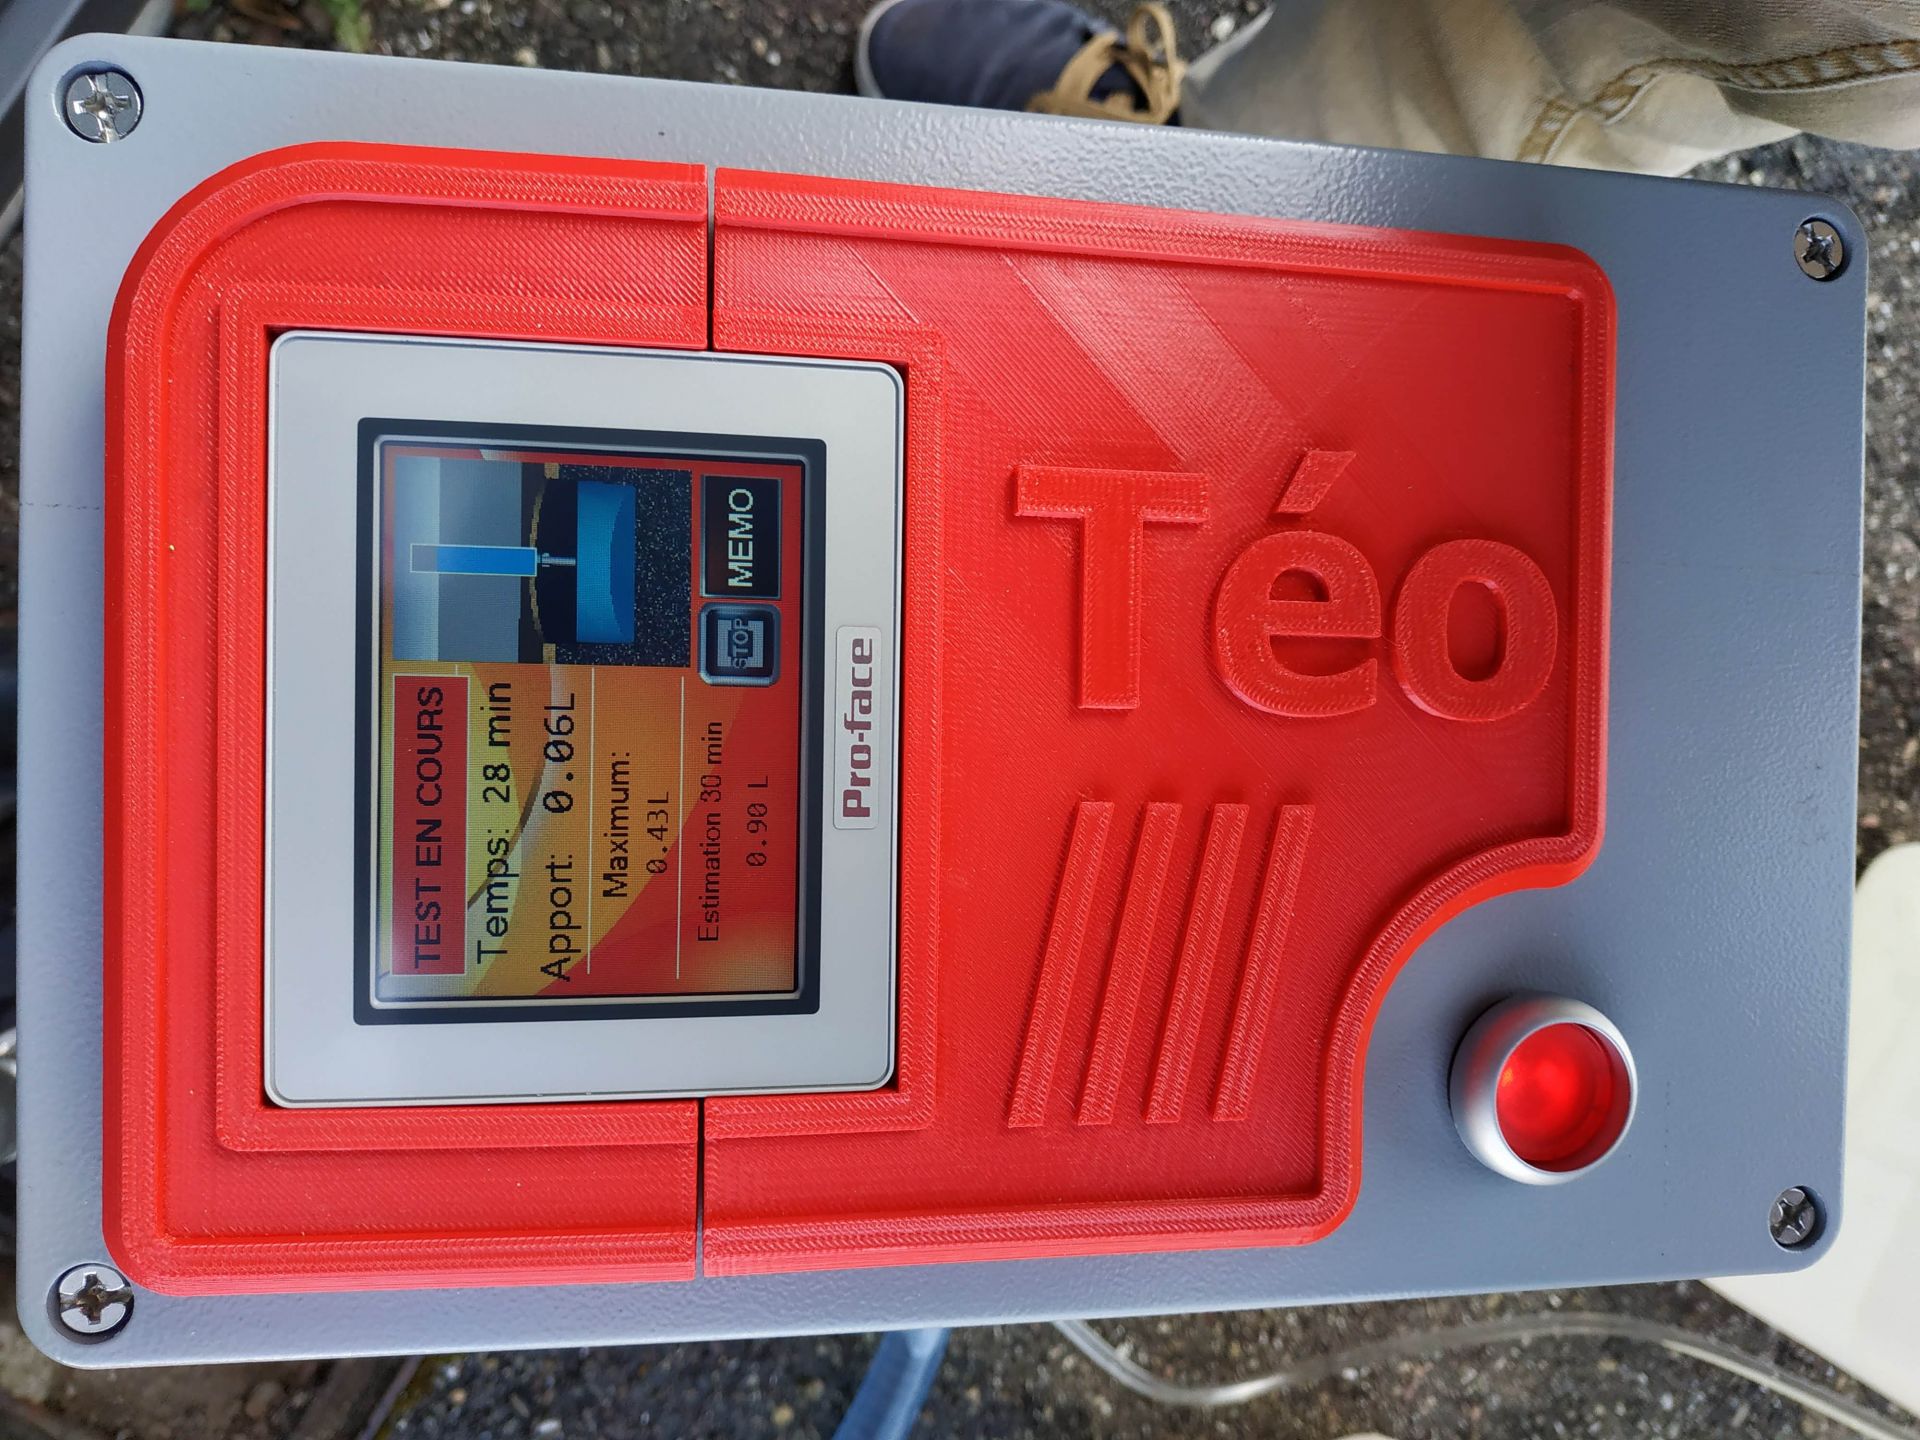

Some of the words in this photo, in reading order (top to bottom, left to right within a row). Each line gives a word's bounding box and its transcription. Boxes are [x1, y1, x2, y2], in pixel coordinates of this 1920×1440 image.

[728, 488, 753, 587] MEMO
[1014, 450, 1558, 722] Téo
[731, 618, 751, 669] STOP
[416, 686, 443, 806] COURS
[480, 682, 511, 747] min
[542, 693, 575, 813] 0.06L
[701, 722, 722, 765] min
[842, 638, 872, 818] Pro-face
[483, 763, 510, 802] 28
[603, 752, 630, 897] Maximum:
[700, 774, 722, 802] 30
[747, 775, 768, 788] L
[416, 819, 443, 866] EN
[698, 812, 721, 941] Estimation
[746, 803, 768, 867] 0.90
[415, 878, 442, 968] TEST
[477, 828, 519, 963] Temps:
[541, 854, 581, 982] Apport:
